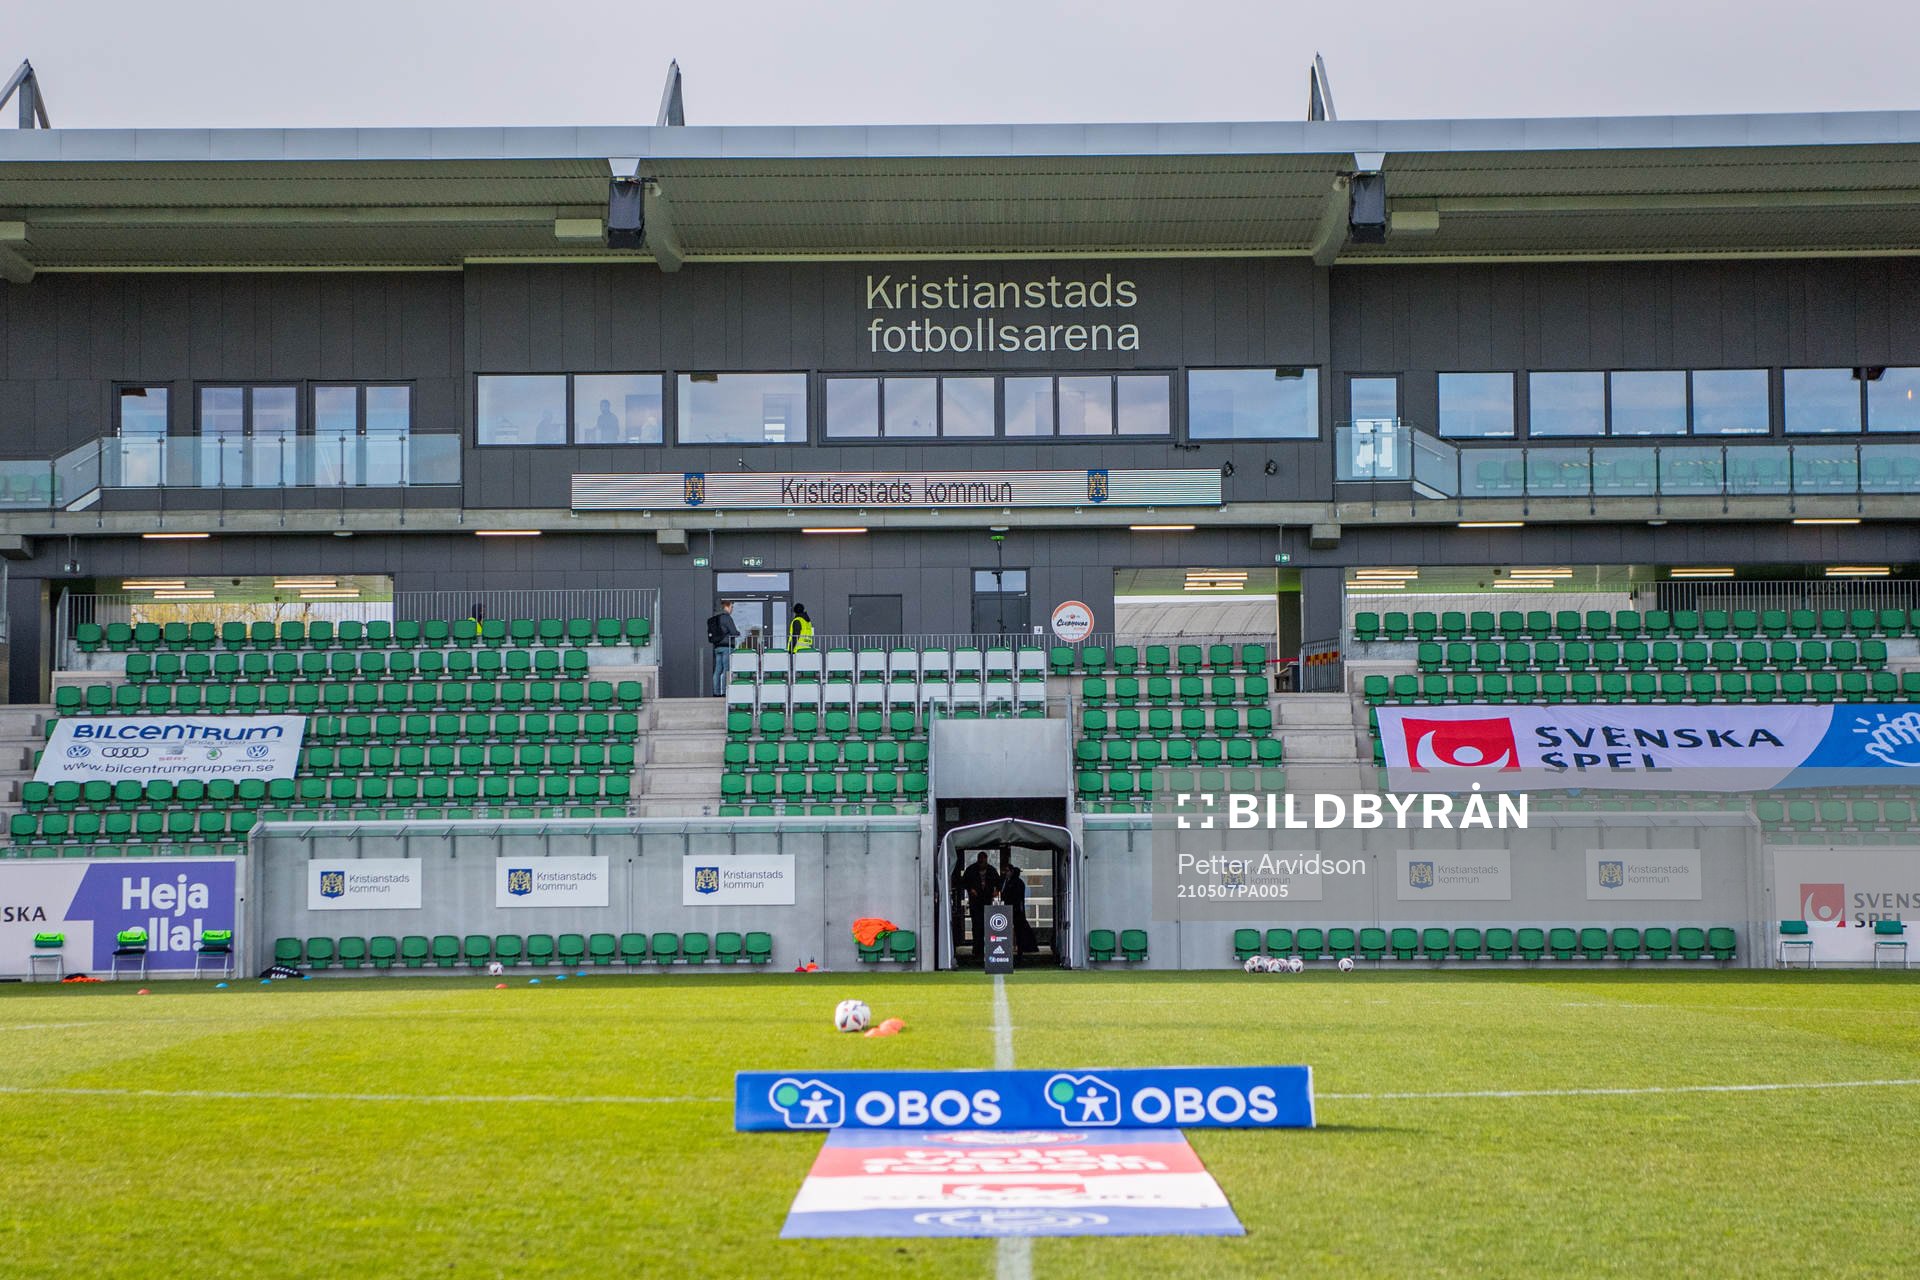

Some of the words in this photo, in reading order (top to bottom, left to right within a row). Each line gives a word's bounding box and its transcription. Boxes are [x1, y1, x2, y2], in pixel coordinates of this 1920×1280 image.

[866, 273, 1137, 309] Kristianstads
[867, 318, 1140, 352] fotbollsarena
[781, 478, 911, 504] Kristianstads
[924, 477, 1012, 503] kommun
[1535, 726, 1785, 748] SVENSKA
[1540, 751, 1673, 773] SPEL
[63, 761, 274, 775] www.bilcentrumgruppen.se
[723, 869, 784, 879] Kristianstads
[1438, 865, 1499, 875] Kristianstads
[1627, 864, 1688, 874] Kristianstads
[349, 873, 410, 883] Kristianstads
[537, 871, 598, 881] Kristianstads
[1438, 876, 1480, 885] kommun
[1627, 875, 1669, 884] kommun
[349, 884, 391, 893] kommun
[537, 882, 579, 891] kommun
[723, 880, 765, 889] kommun
[121, 873, 209, 917] Heja
[0, 906, 47, 922] SKA
[855, 1090, 1002, 1126] OBOS
[1132, 1086, 1278, 1123] OBOS
